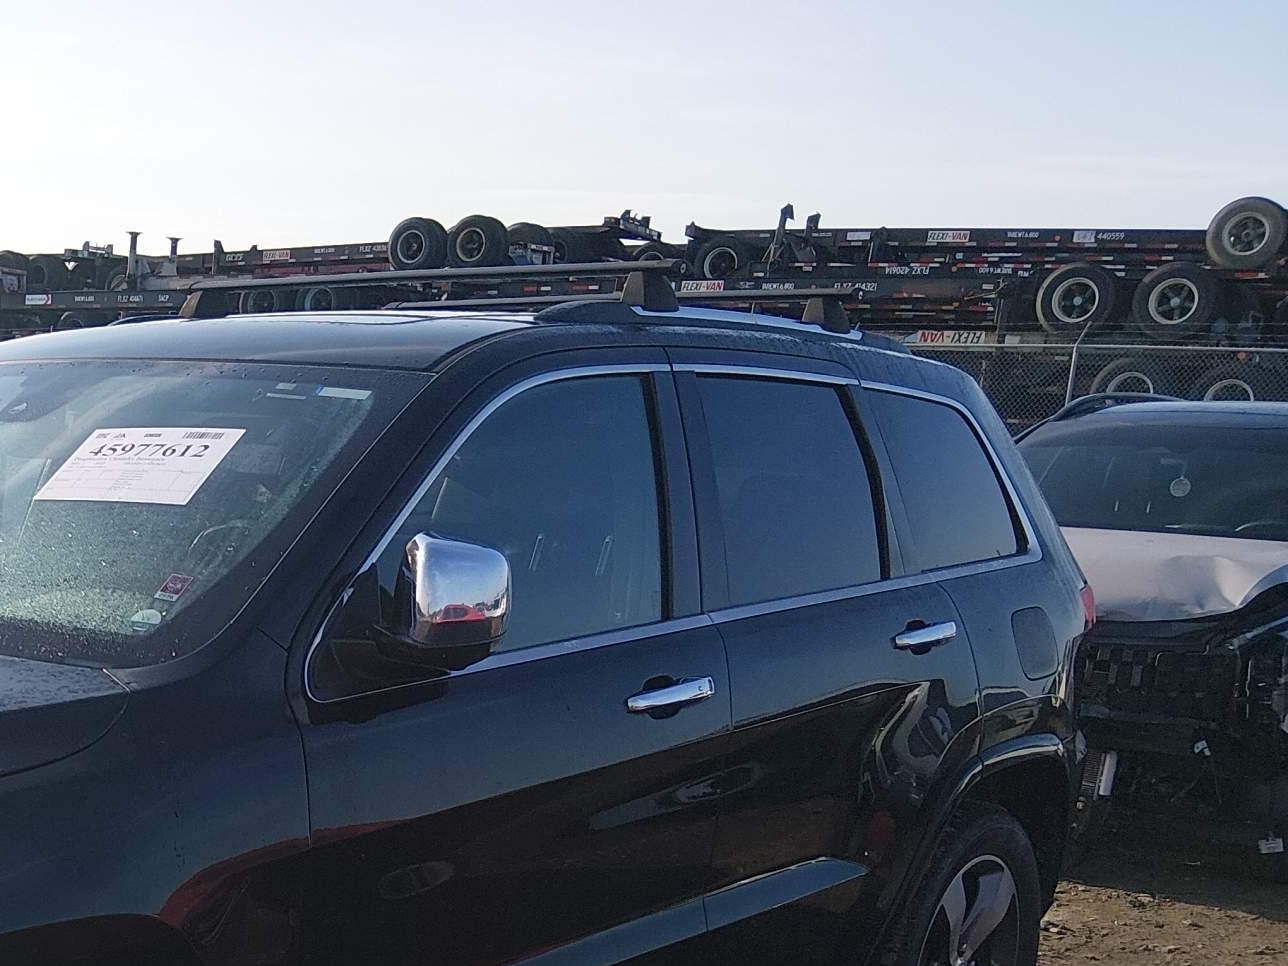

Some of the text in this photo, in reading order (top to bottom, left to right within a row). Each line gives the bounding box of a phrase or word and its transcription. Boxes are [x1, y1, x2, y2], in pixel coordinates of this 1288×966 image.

[927, 231, 969, 241] FLEXI-VAN
[681, 280, 723, 291] FLEXI-VAN
[919, 331, 983, 344] FLEXI-VAN
[88, 443, 211, 458] 45977612
